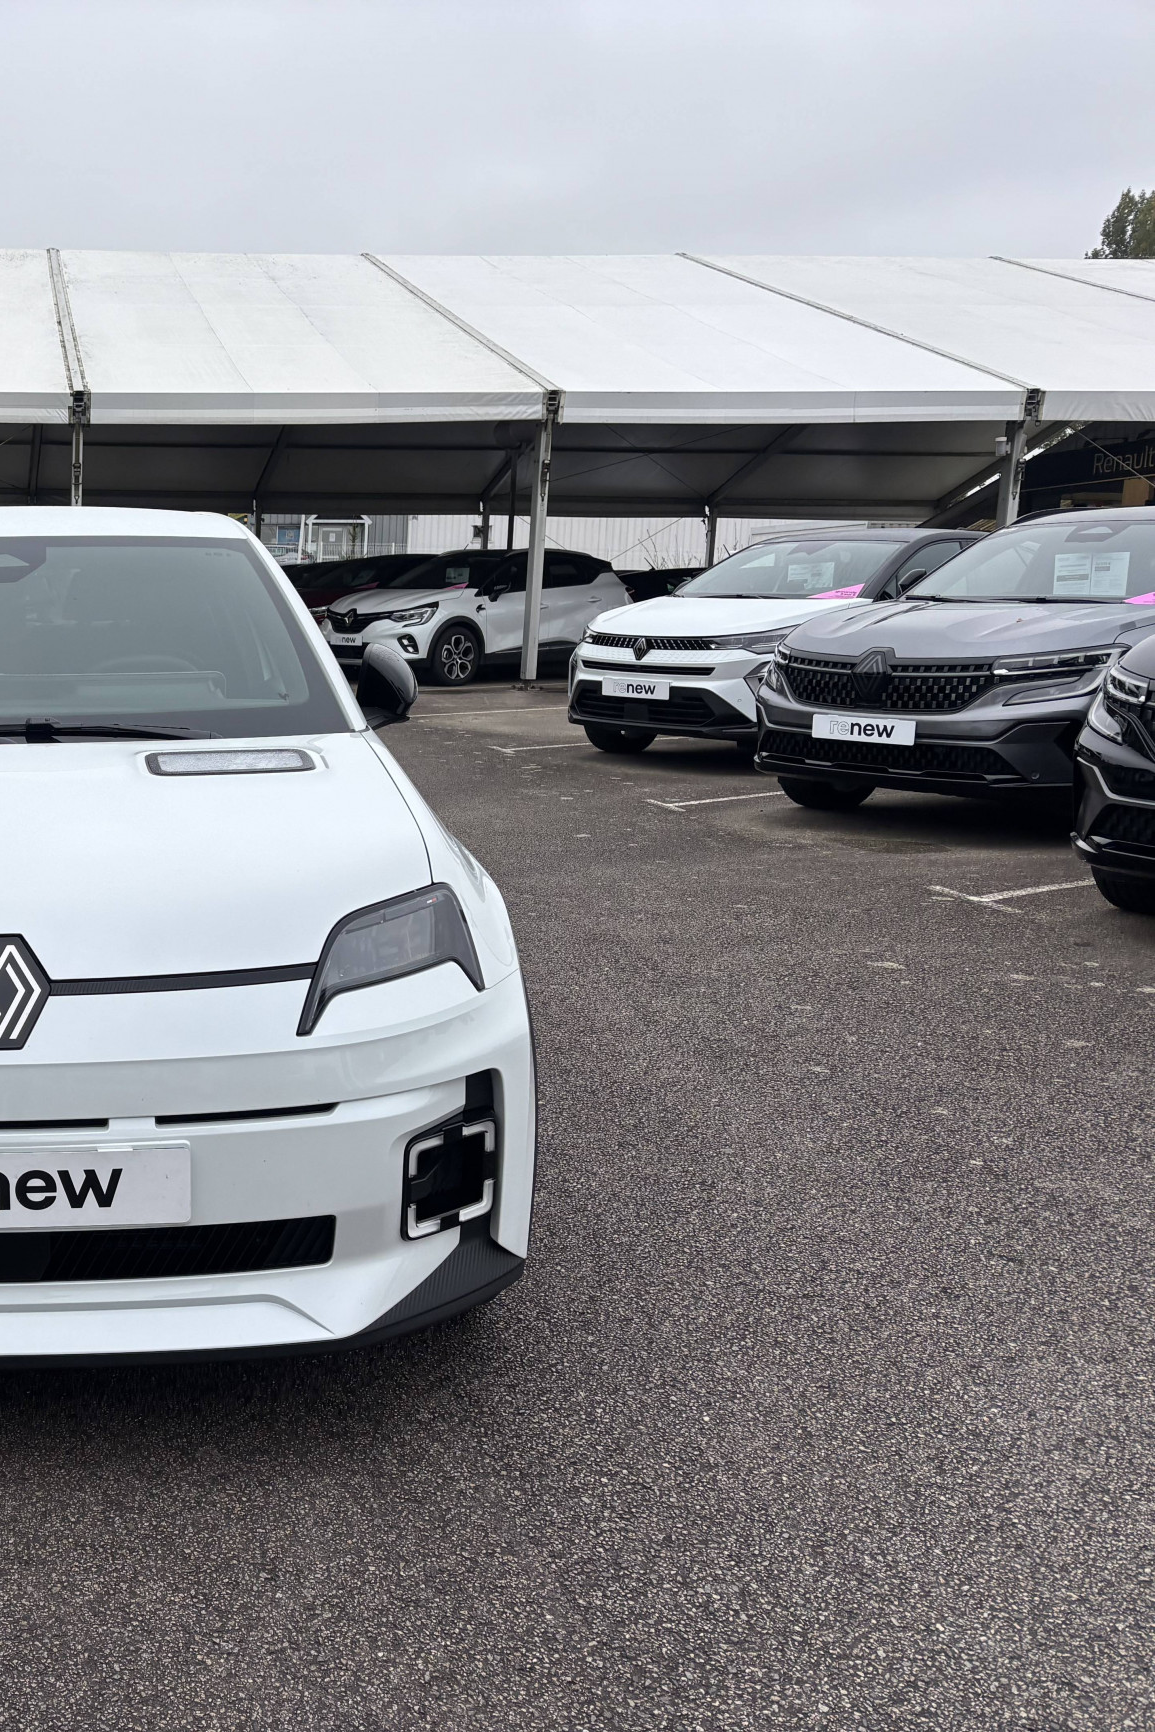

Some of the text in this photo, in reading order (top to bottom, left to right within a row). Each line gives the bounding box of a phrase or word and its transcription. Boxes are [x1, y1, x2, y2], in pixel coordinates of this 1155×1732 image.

[1092, 445, 1155, 476] Renault
[612, 681, 656, 695] renew
[829, 720, 895, 739] renew
